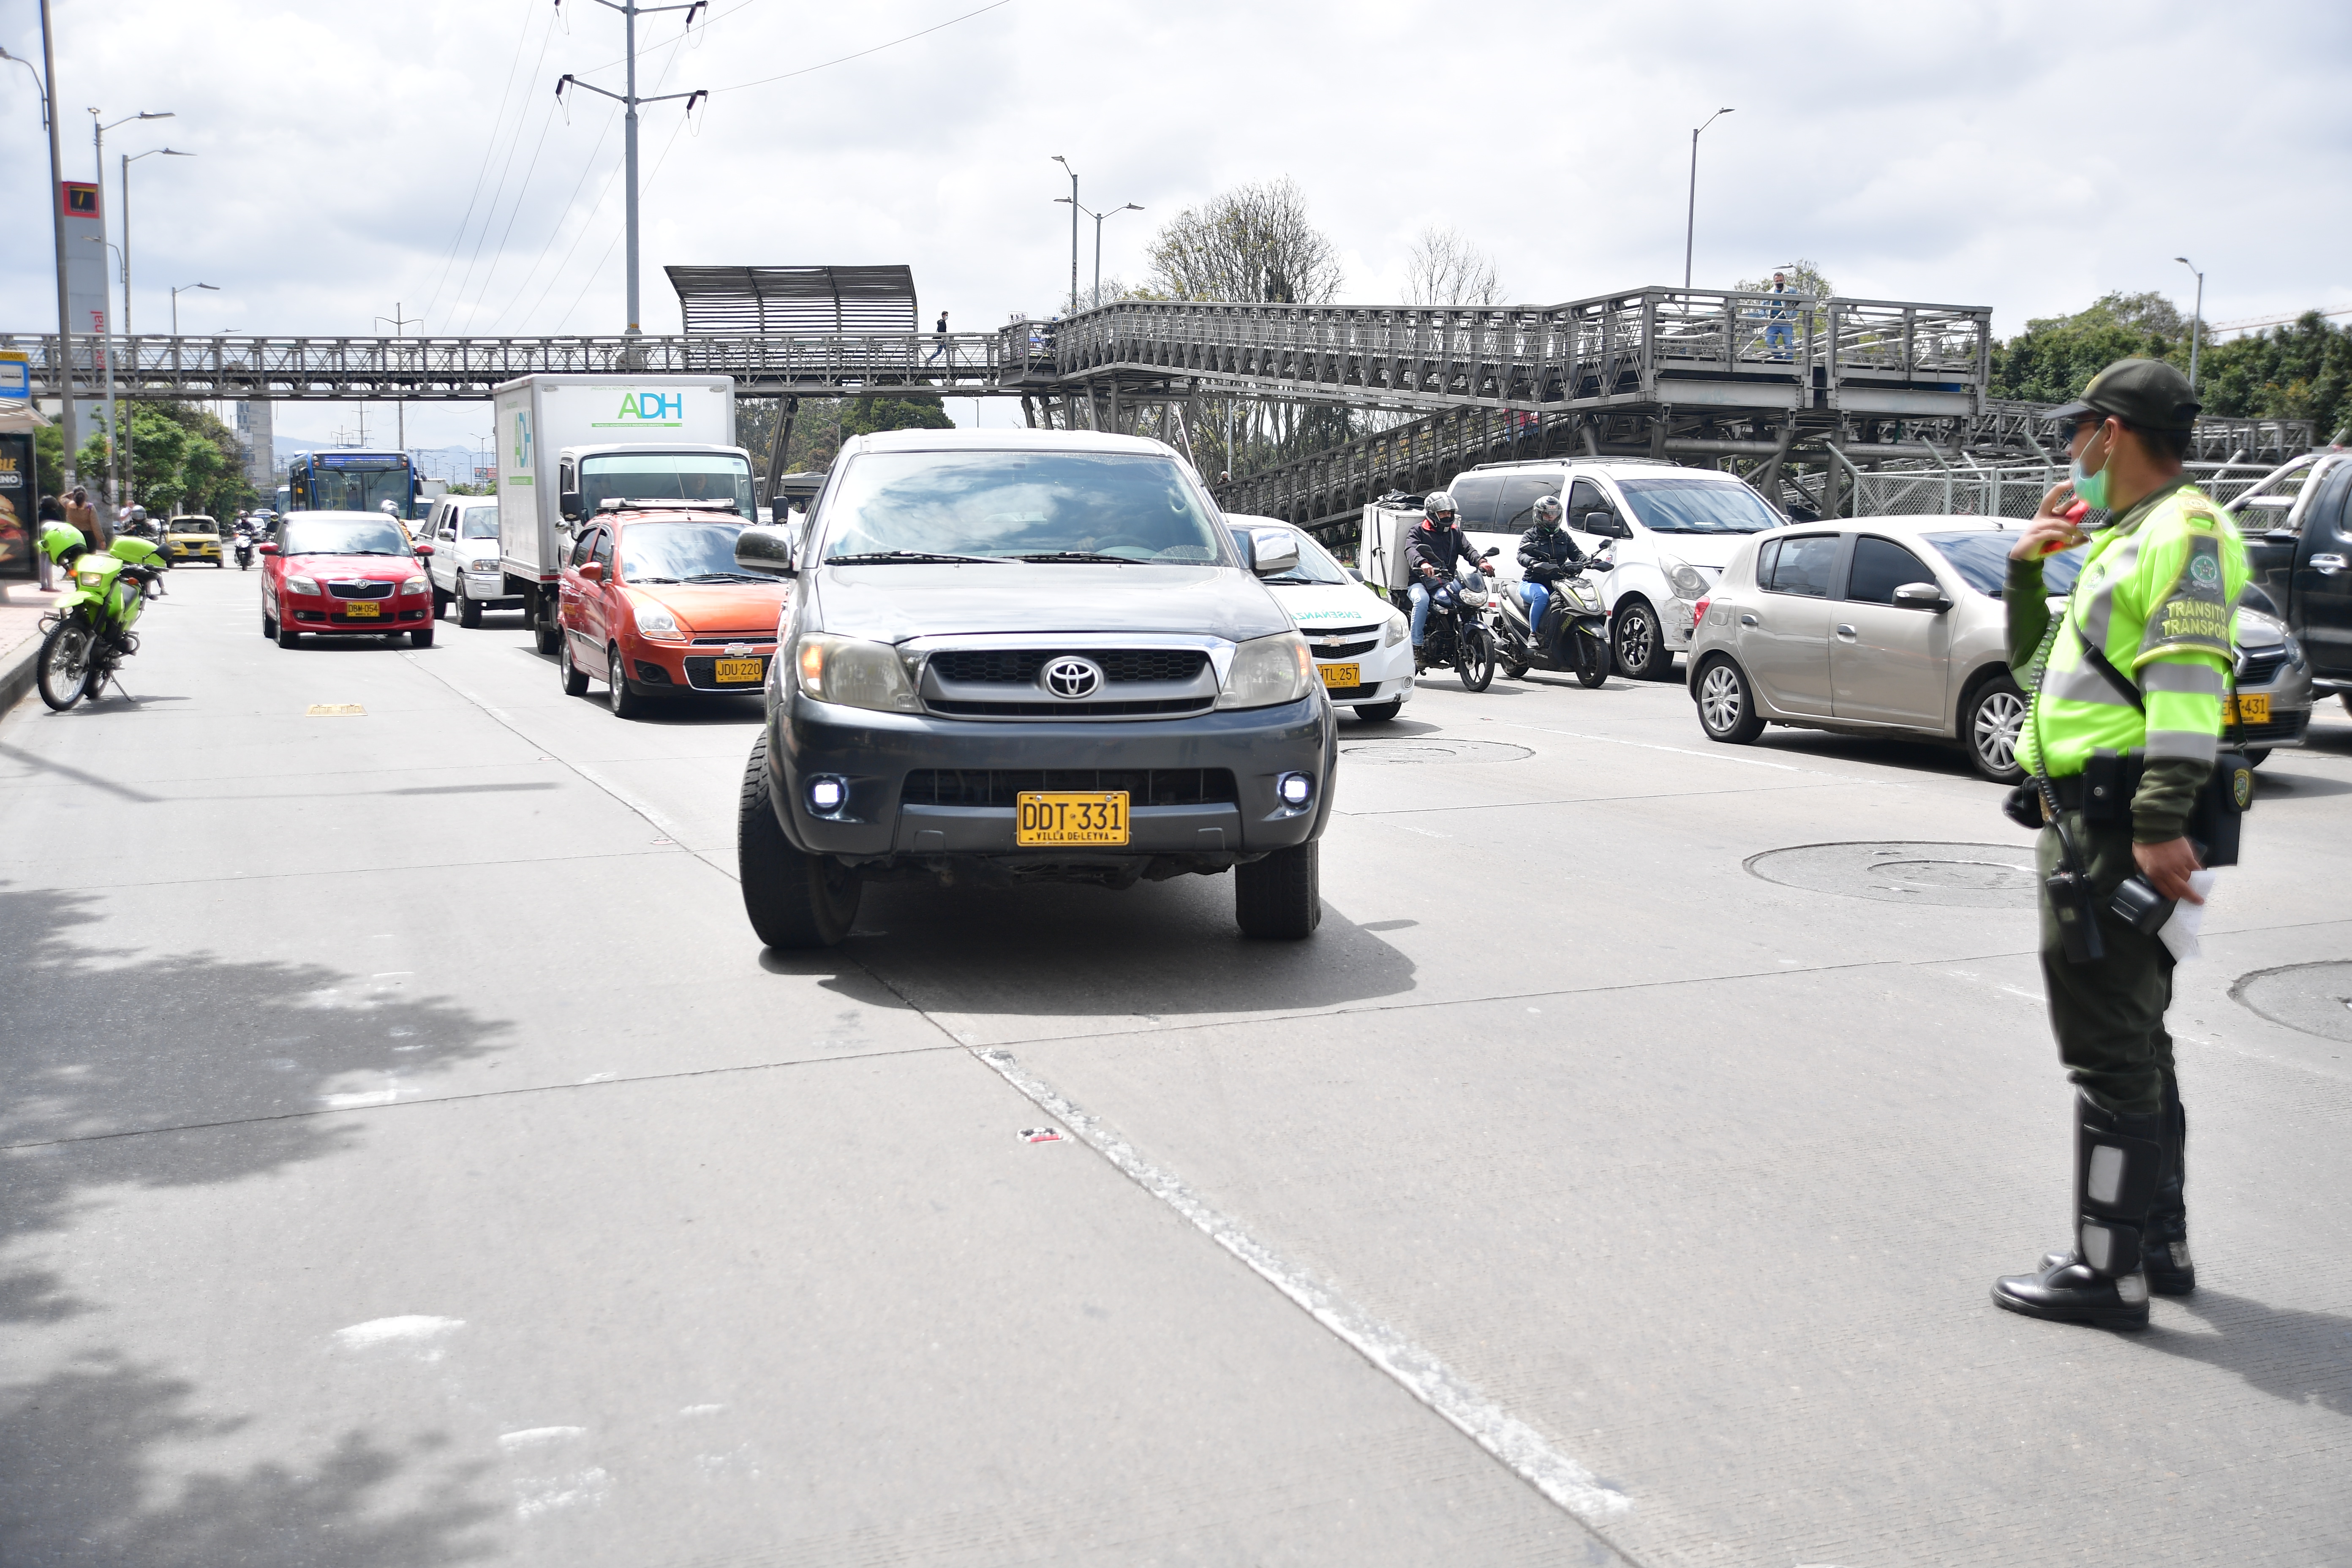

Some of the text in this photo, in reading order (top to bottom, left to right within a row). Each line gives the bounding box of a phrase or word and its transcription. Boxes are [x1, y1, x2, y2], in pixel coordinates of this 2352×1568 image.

[618, 393, 682, 419] ADH
[515, 410, 533, 468] ADH
[2167, 596, 2226, 623] TRÁNSITO
[1037, 832, 1064, 840] VILLA
[1081, 832, 1109, 840] LEYVA
